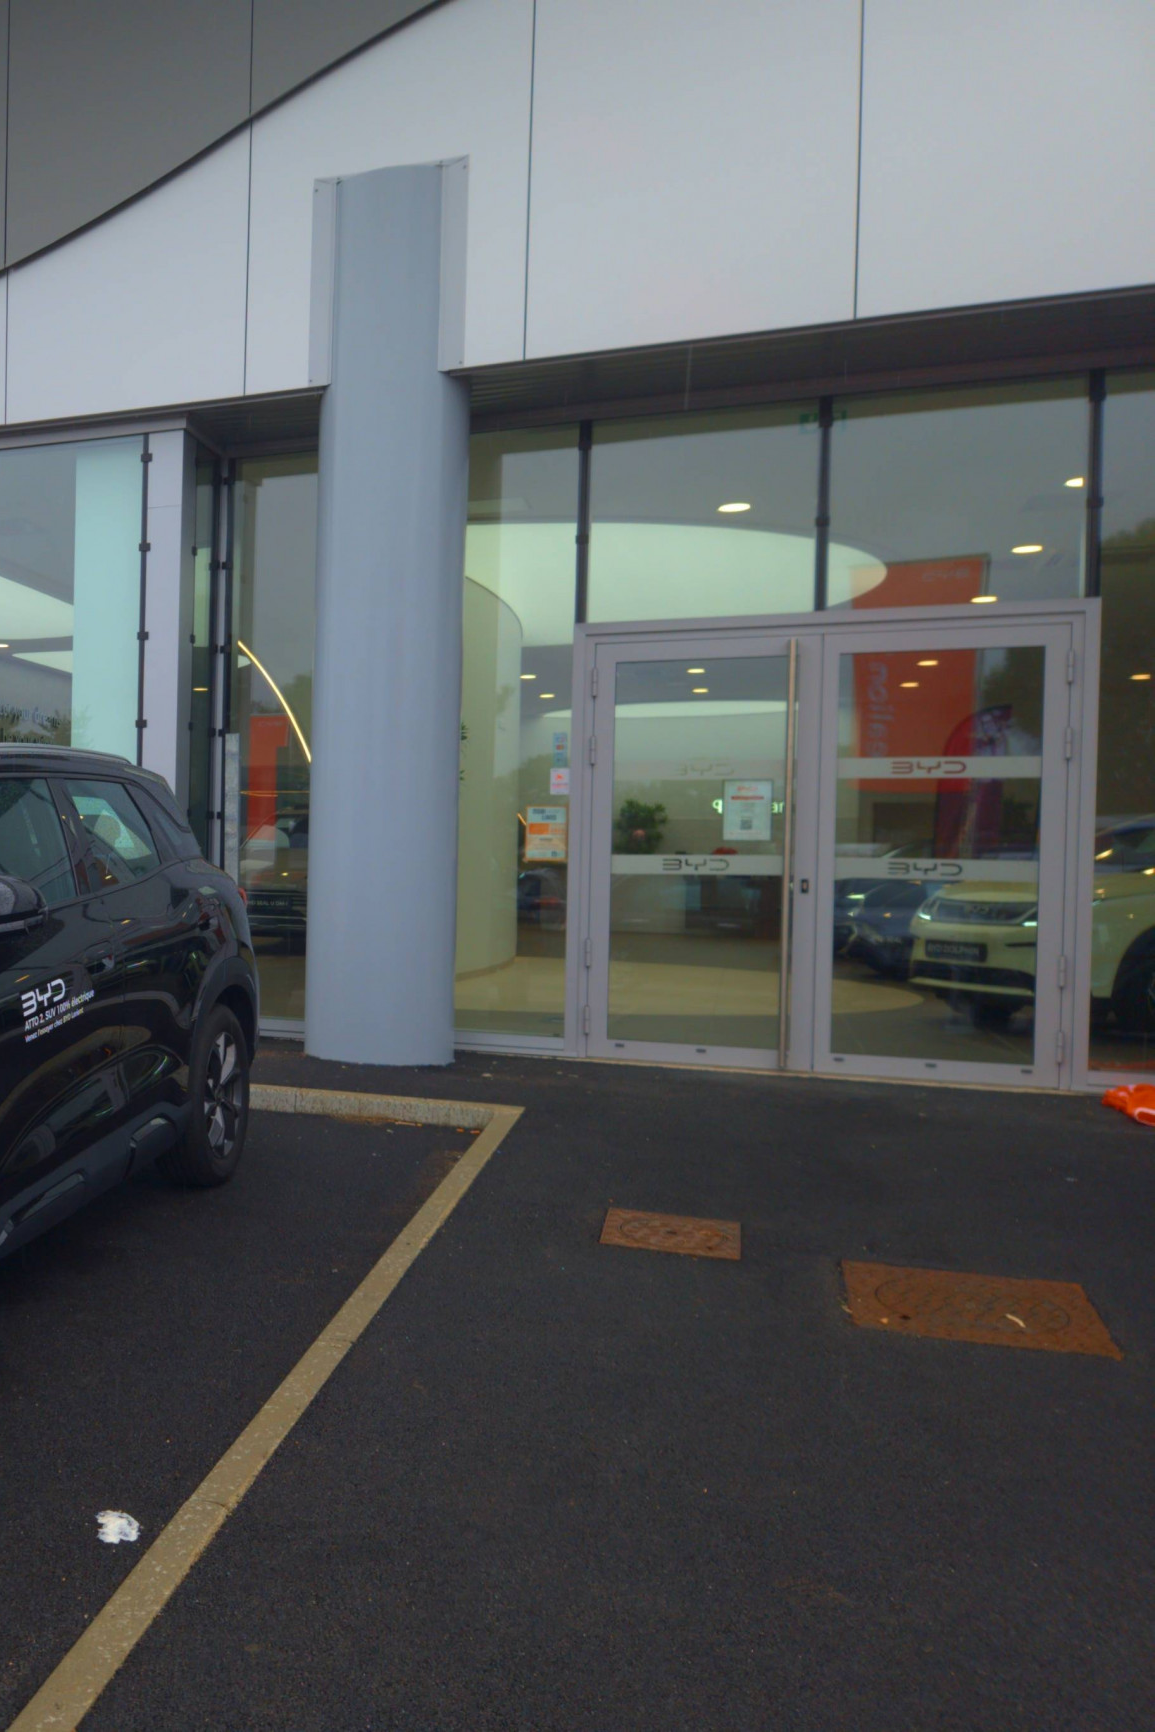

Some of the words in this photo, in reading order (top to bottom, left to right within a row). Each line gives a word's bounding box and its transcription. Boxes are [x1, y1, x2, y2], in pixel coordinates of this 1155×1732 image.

[890, 761, 967, 775] BYD
[662, 858, 730, 871] BYD
[887, 861, 964, 876] BYD
[21, 979, 65, 1017] BYD
[25, 1015, 39, 1031] ATTO
[45, 1006, 56, 1020] SUV
[57, 1000, 71, 1014] 100%
[71, 989, 95, 1007] électrique
